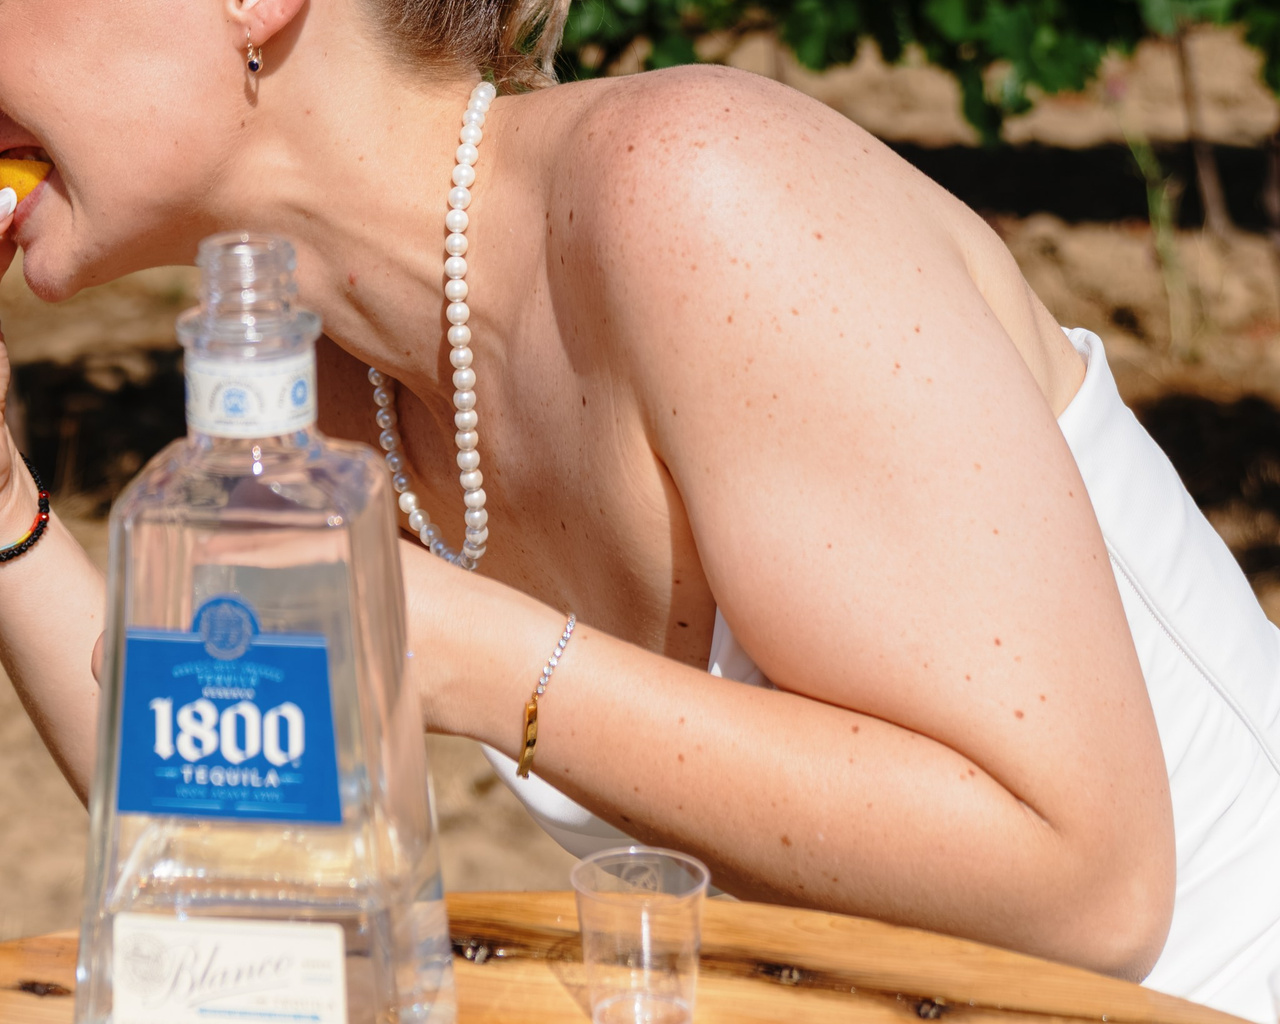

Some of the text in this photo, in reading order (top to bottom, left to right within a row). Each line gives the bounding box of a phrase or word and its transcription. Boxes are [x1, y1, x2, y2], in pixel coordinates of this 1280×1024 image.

[149, 696, 305, 767] 1800
[180, 764, 281, 788] TEQUILA
[152, 937, 295, 1006] Blanco
